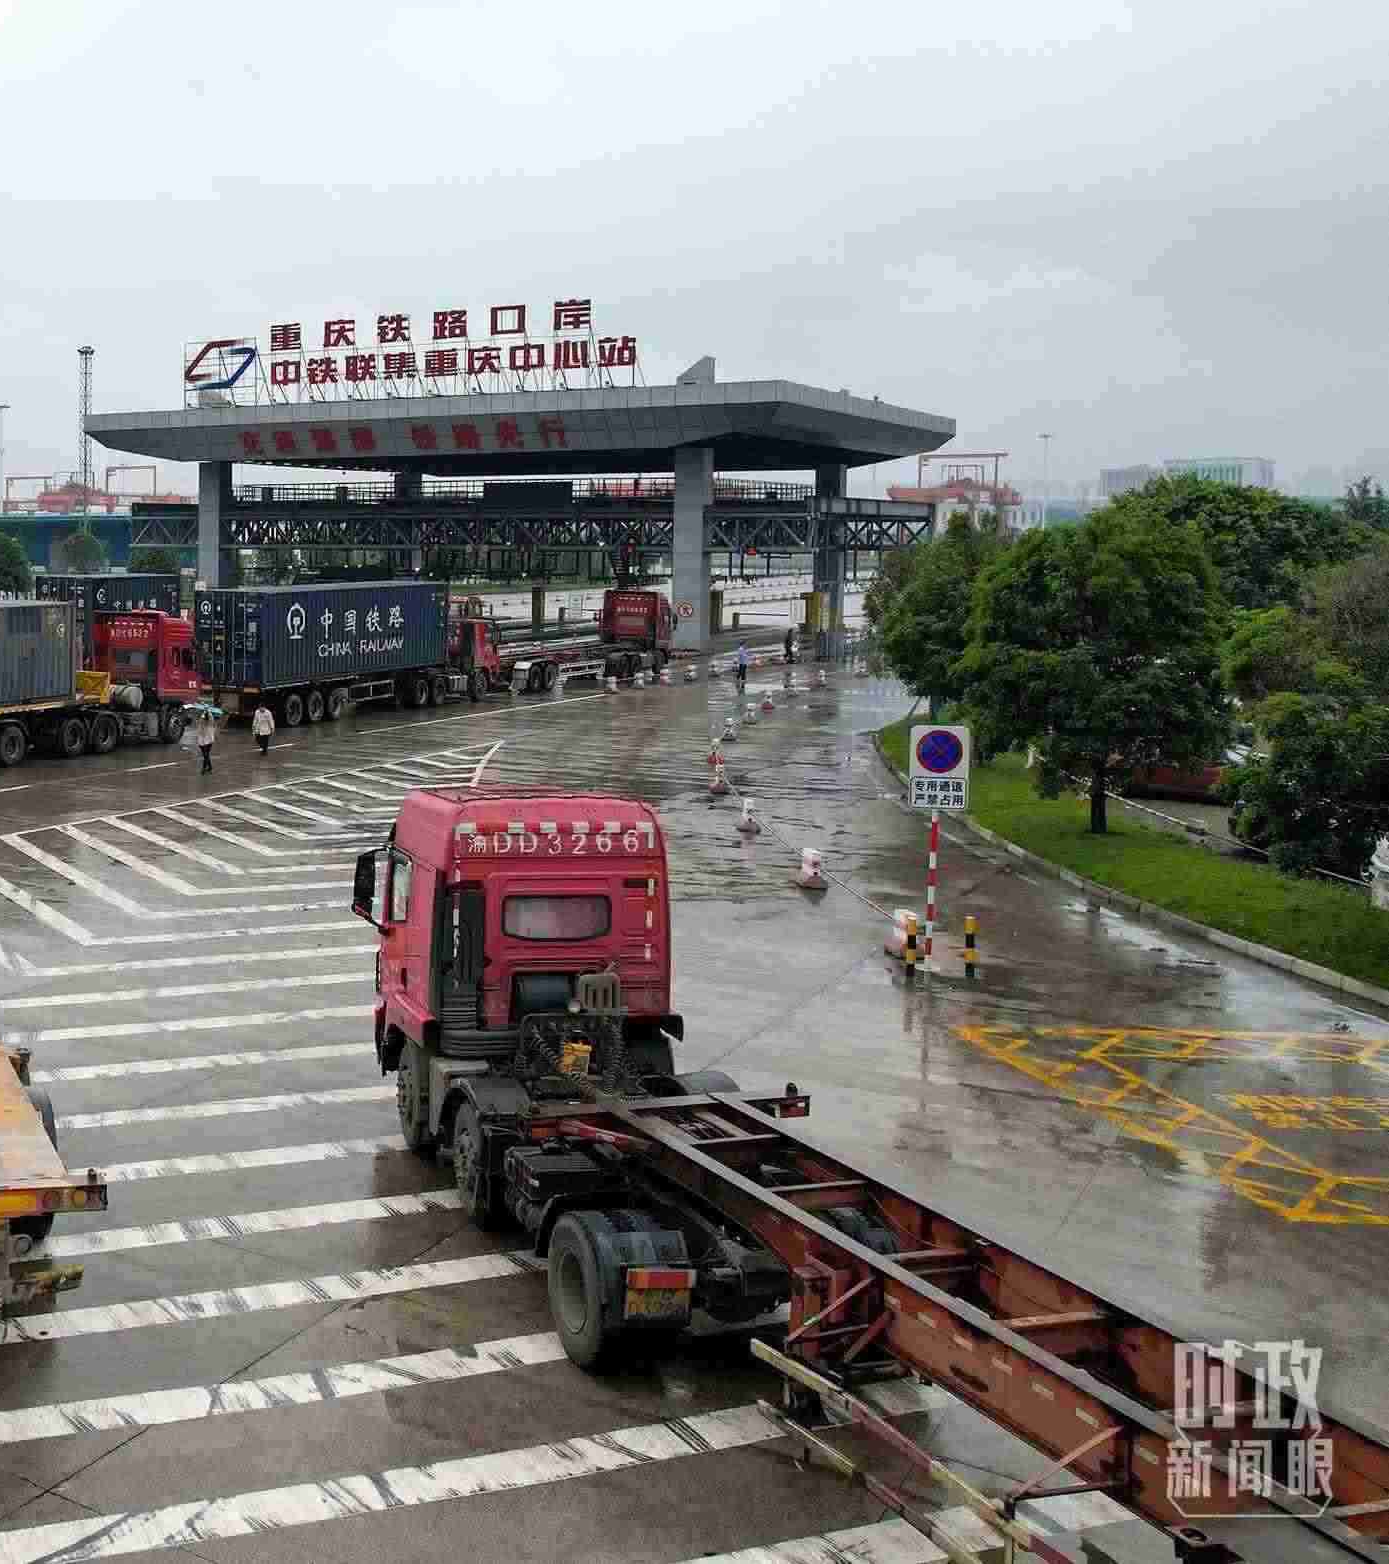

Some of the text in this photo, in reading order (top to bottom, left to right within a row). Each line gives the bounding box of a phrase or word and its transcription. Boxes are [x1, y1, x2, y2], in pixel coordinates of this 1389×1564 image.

[270, 298, 592, 352] 重庆铁路口岸
[270, 335, 637, 386] 中铁联集重庆中心站
[319, 604, 405, 640] 中国铁路
[317, 636, 405, 657] CHINA RAILWAY
[915, 780, 963, 793] 专用通道
